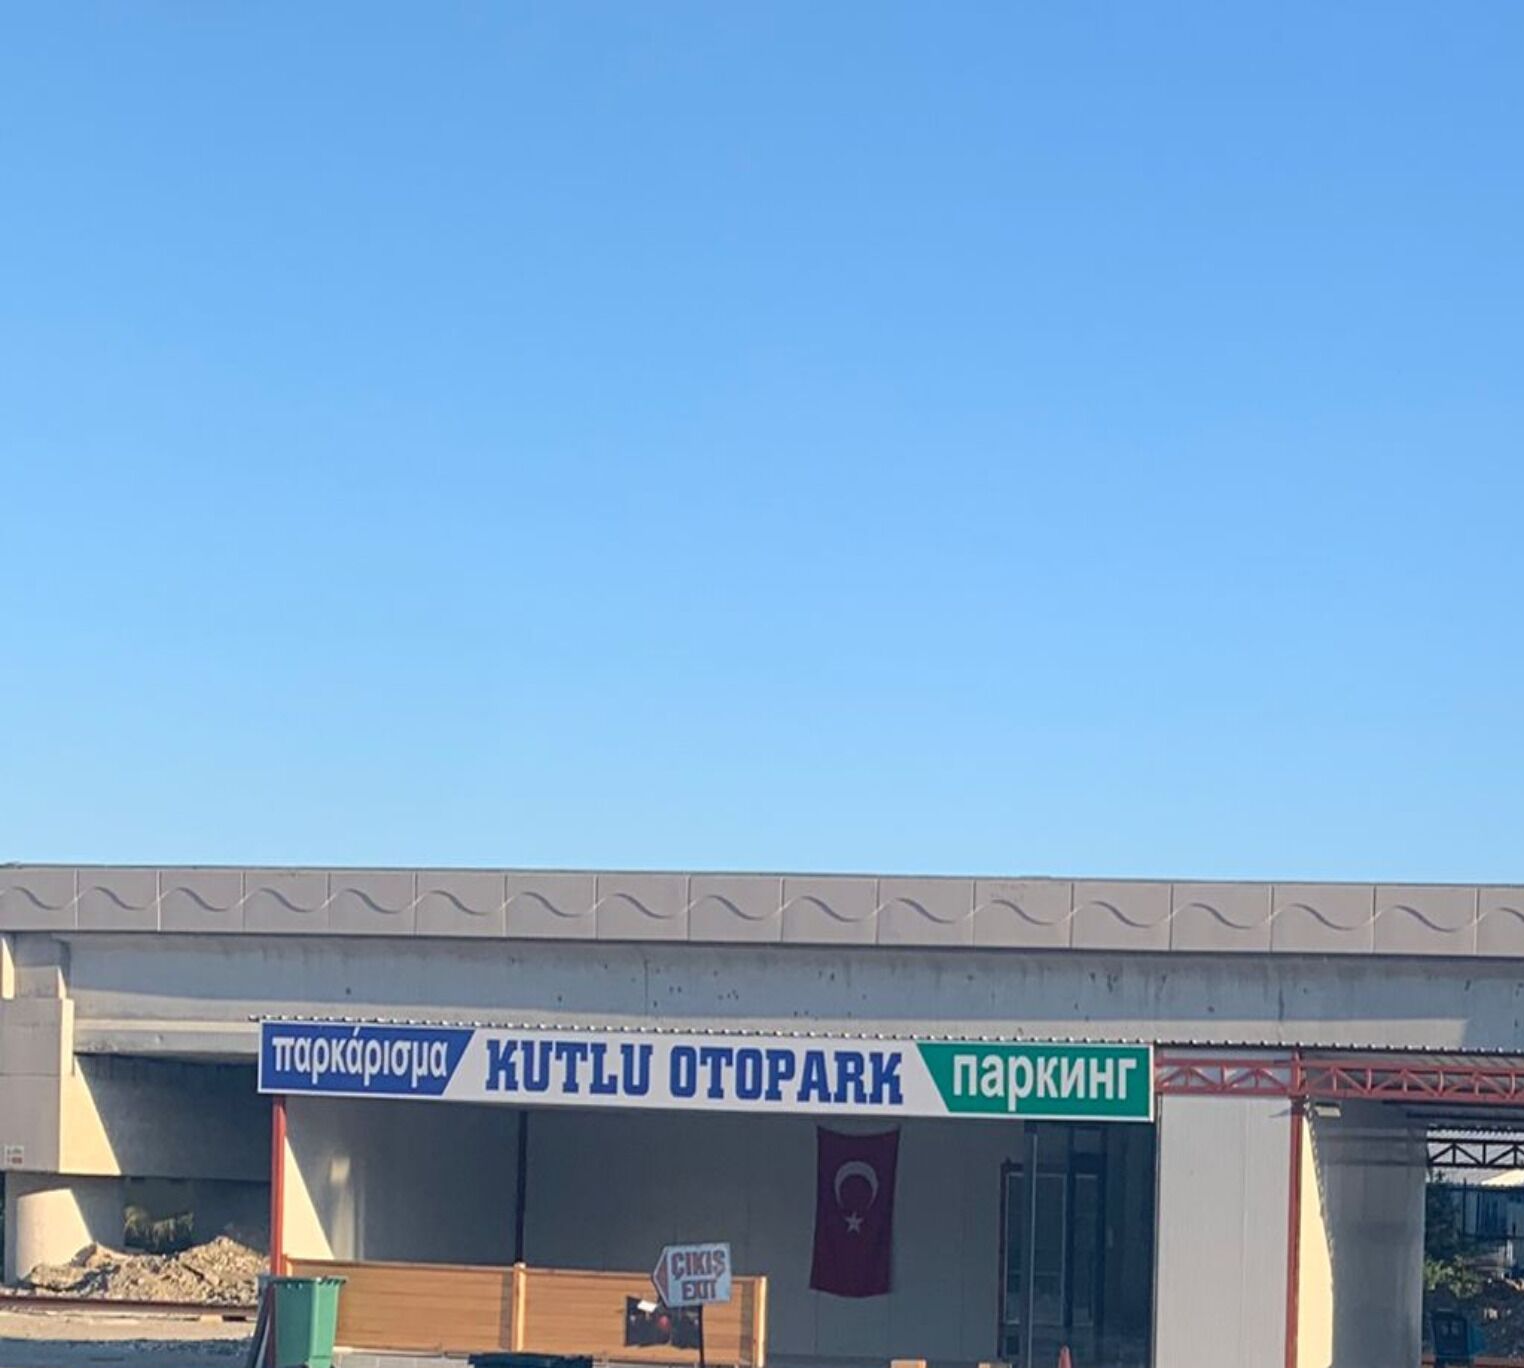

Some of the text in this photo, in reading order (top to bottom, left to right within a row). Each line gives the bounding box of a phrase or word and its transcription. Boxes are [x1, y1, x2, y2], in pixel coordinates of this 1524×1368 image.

[271, 1028, 448, 1087] παρκάρισμα
[485, 1038, 904, 1106] KUTLU OTOPARK
[953, 1053, 1137, 1112] паркинг
[681, 1279, 717, 1301] EXIT
